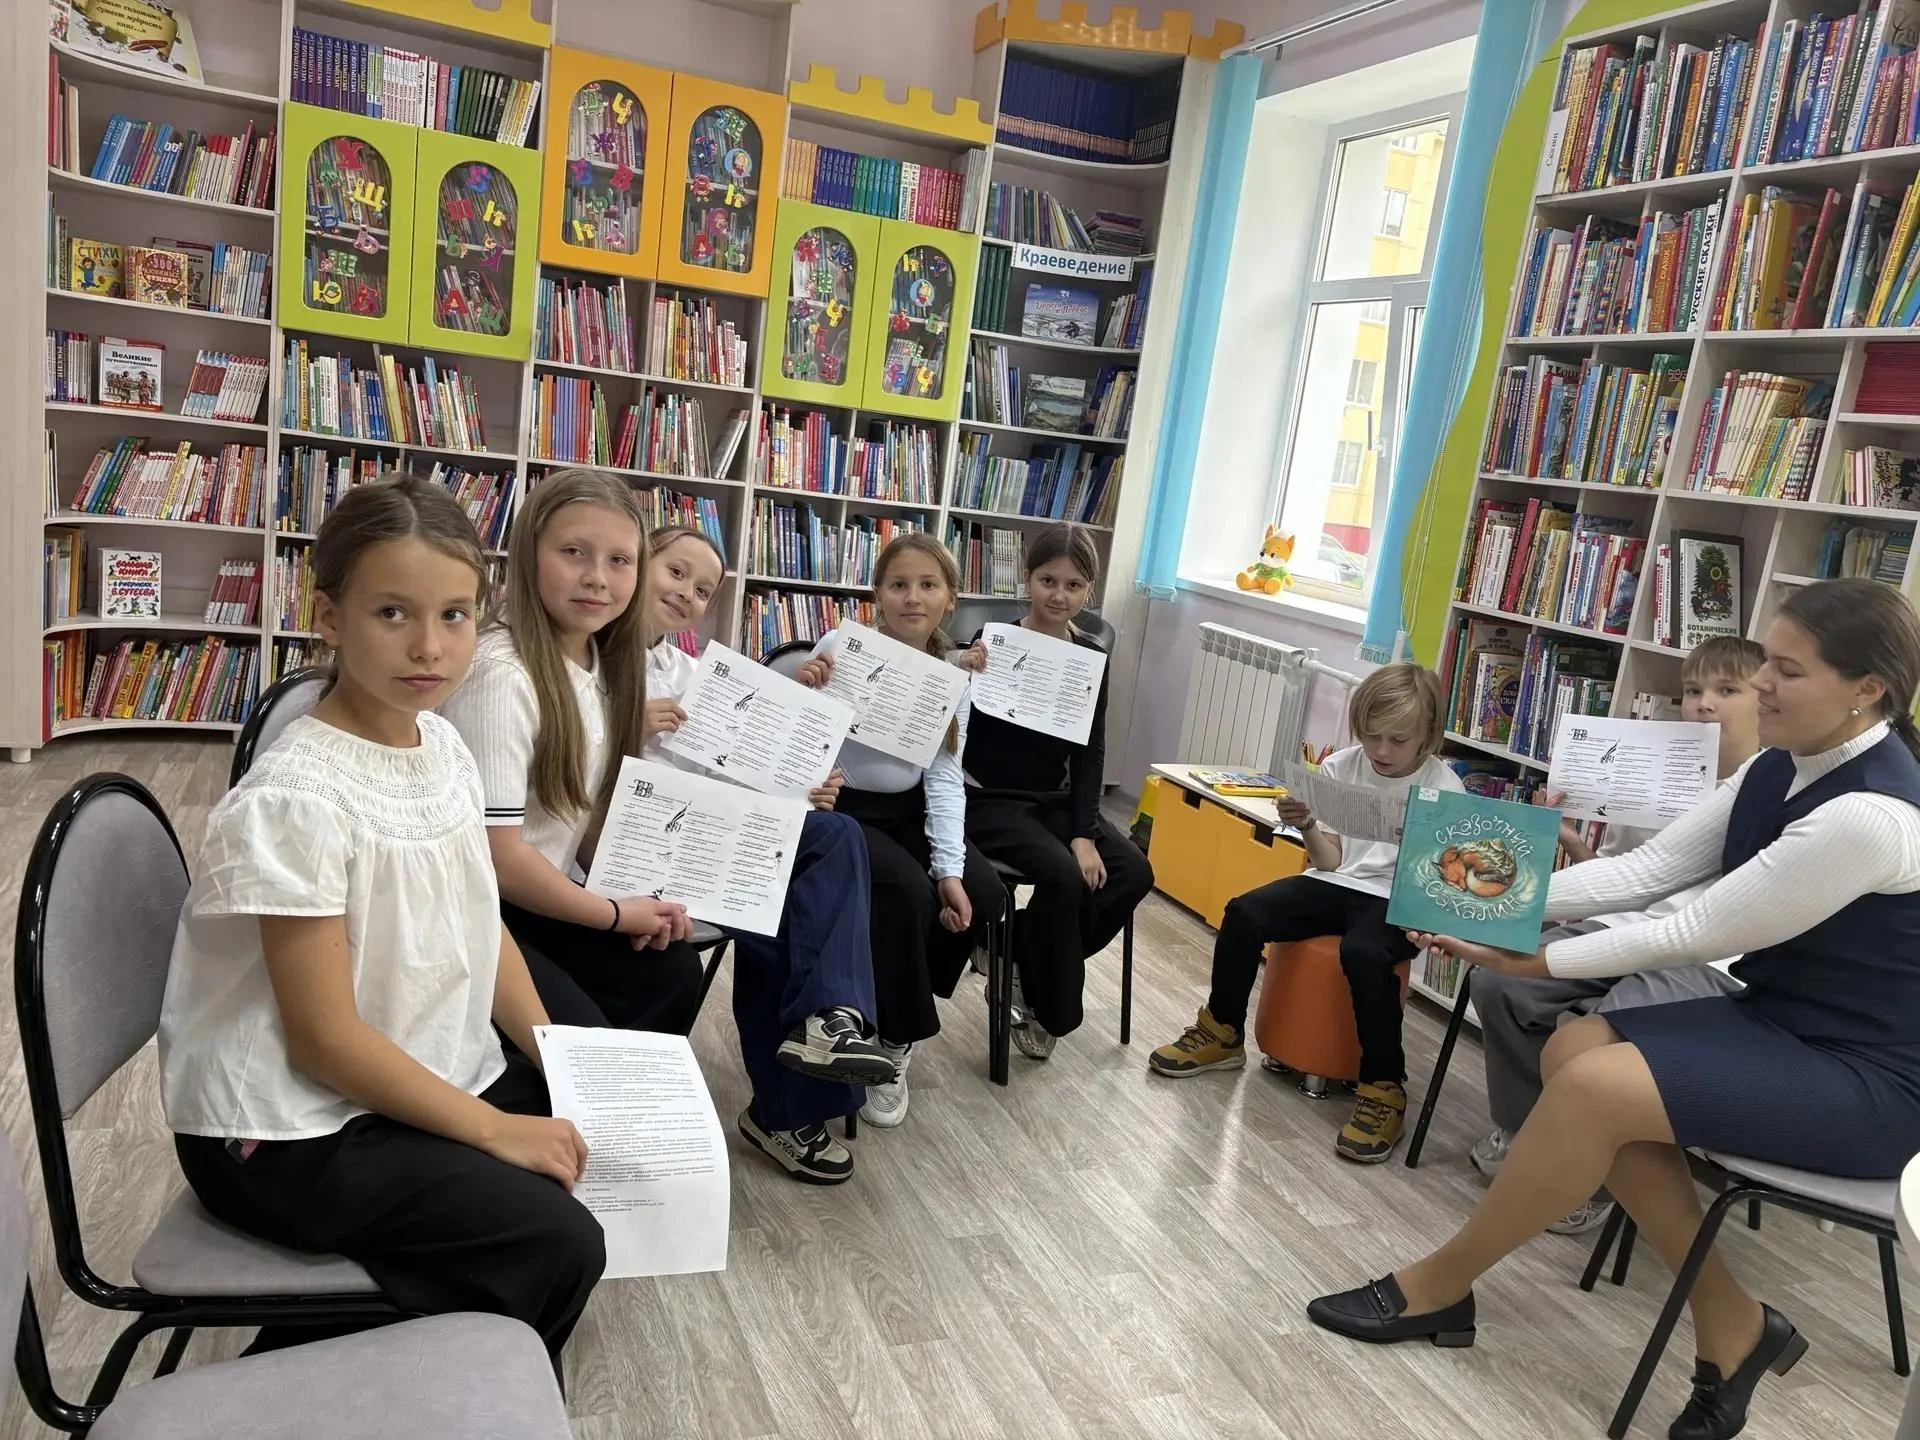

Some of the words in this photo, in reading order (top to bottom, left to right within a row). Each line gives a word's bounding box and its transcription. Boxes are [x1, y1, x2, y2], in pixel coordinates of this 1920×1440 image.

[1815, 32, 1825, 46] 365
[1820, 60, 1832, 84] 365
[1546, 131, 1558, 167] Сказки
[78, 247, 119, 258] СТИХИ
[1020, 248, 1126, 275] Краеведение
[1690, 266, 1706, 323] РУССКИЕ
[1701, 214, 1716, 264] СКАЗКИ
[111, 351, 152, 362] Великие
[116, 560, 153, 569] БОЛЬШАЯ
[119, 568, 148, 576] КНИГА
[1687, 624, 1736, 634] БОТАНИЧЕСКИЕ
[1435, 813, 1535, 858] Сказочный
[1425, 880, 1523, 921] Сахалин
